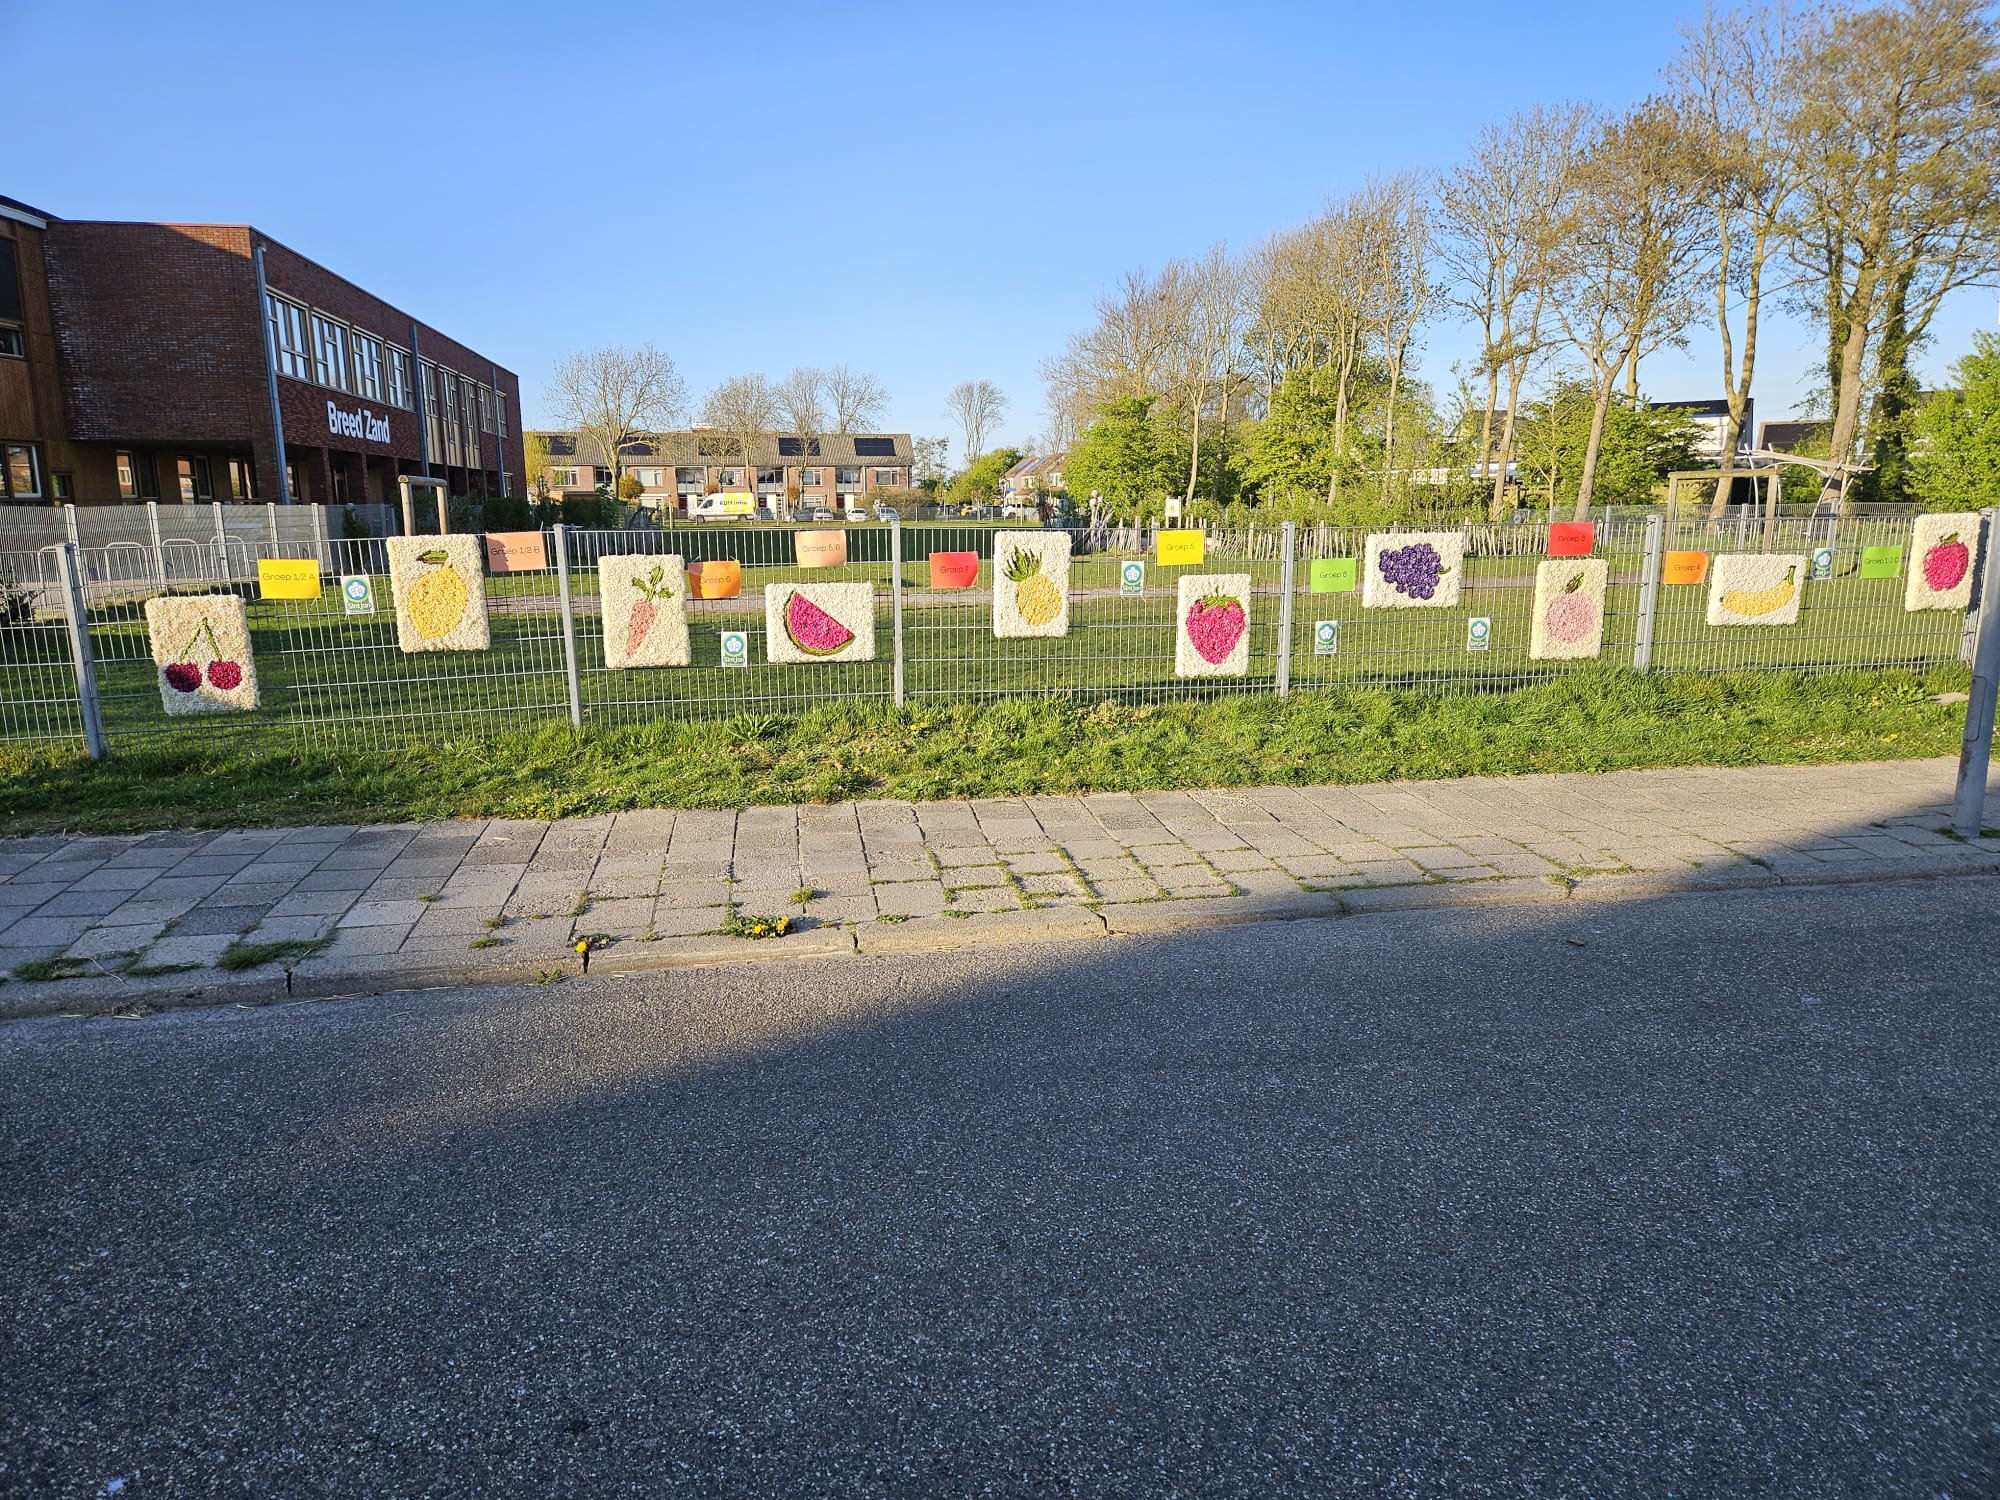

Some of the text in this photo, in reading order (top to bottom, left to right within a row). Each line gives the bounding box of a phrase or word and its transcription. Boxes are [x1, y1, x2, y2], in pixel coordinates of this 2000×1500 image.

[327, 400, 391, 444] Breed Zand
[1558, 535, 1580, 544] Groep
[491, 547, 518, 556] Groep
[533, 545, 541, 554] B
[802, 545, 827, 553] Groep
[1166, 543, 1189, 552] Groep
[940, 566, 964, 575] Groep
[1674, 563, 1696, 572] Groep
[262, 572, 316, 582] Groep 1/2 A
[1319, 571, 1342, 580] Groep
[698, 576, 725, 586] Groep
